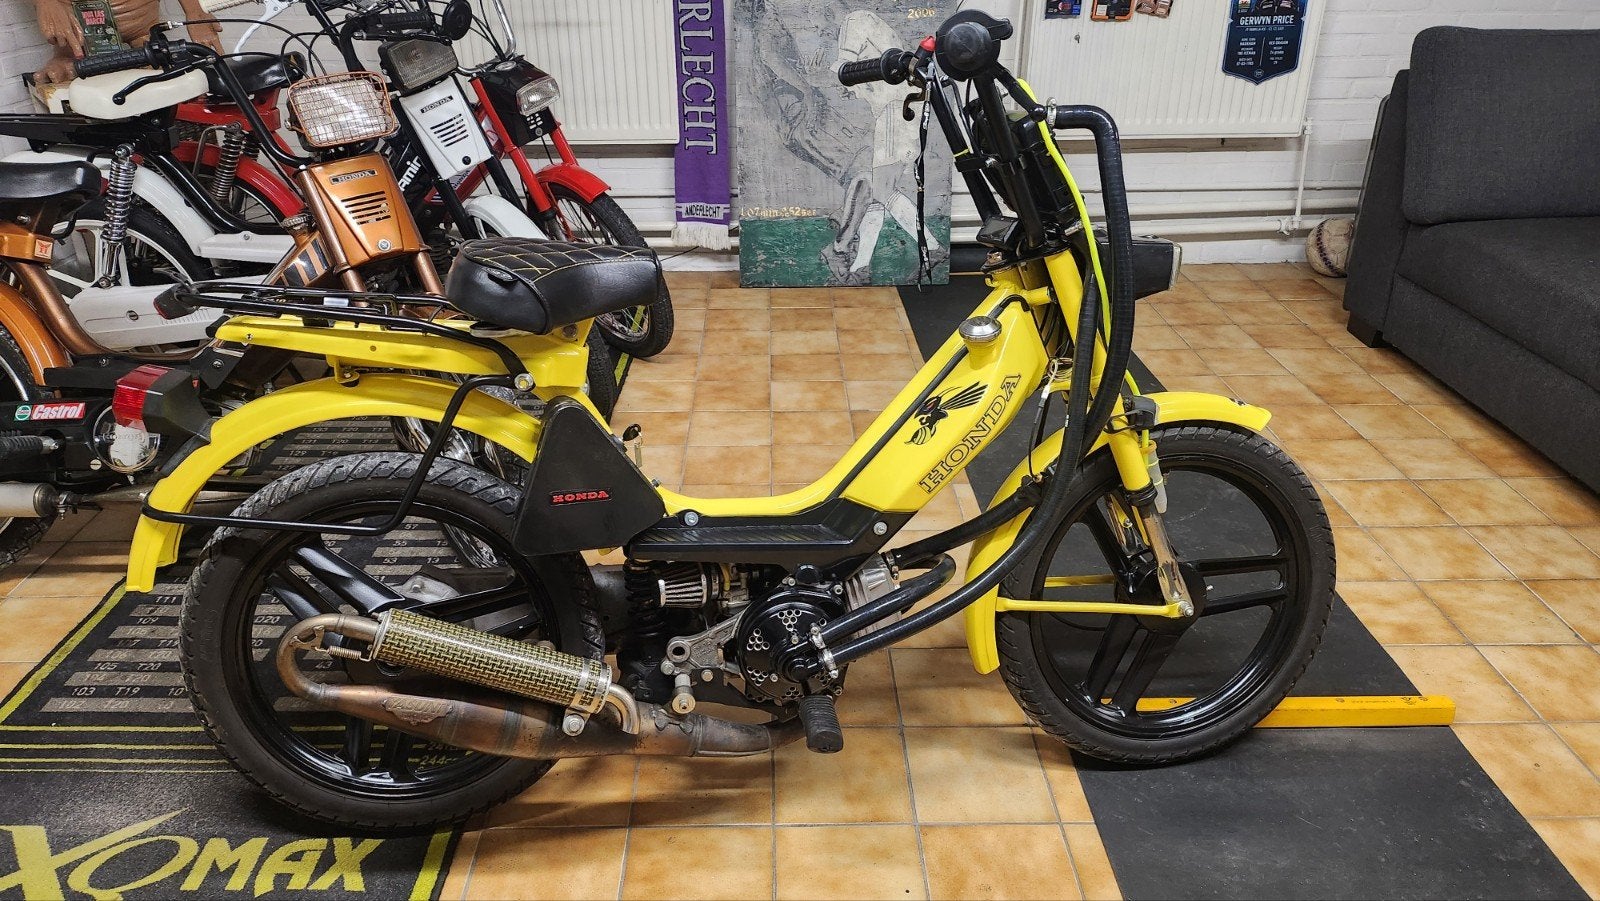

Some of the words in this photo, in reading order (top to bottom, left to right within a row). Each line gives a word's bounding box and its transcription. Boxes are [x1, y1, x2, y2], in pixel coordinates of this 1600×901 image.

[1240, 16, 1271, 25] GERWYN
[1273, 15, 1295, 24] PRICE
[423, 97, 452, 112] HONDA
[337, 170, 372, 182] HONDA
[32, 403, 84, 419] Castrol
[920, 373, 1021, 493] HONDA
[553, 491, 609, 502] HONDA
[71, 687, 97, 696] 103
[115, 687, 141, 696] T19
[0, 807, 386, 901] XOMAX
